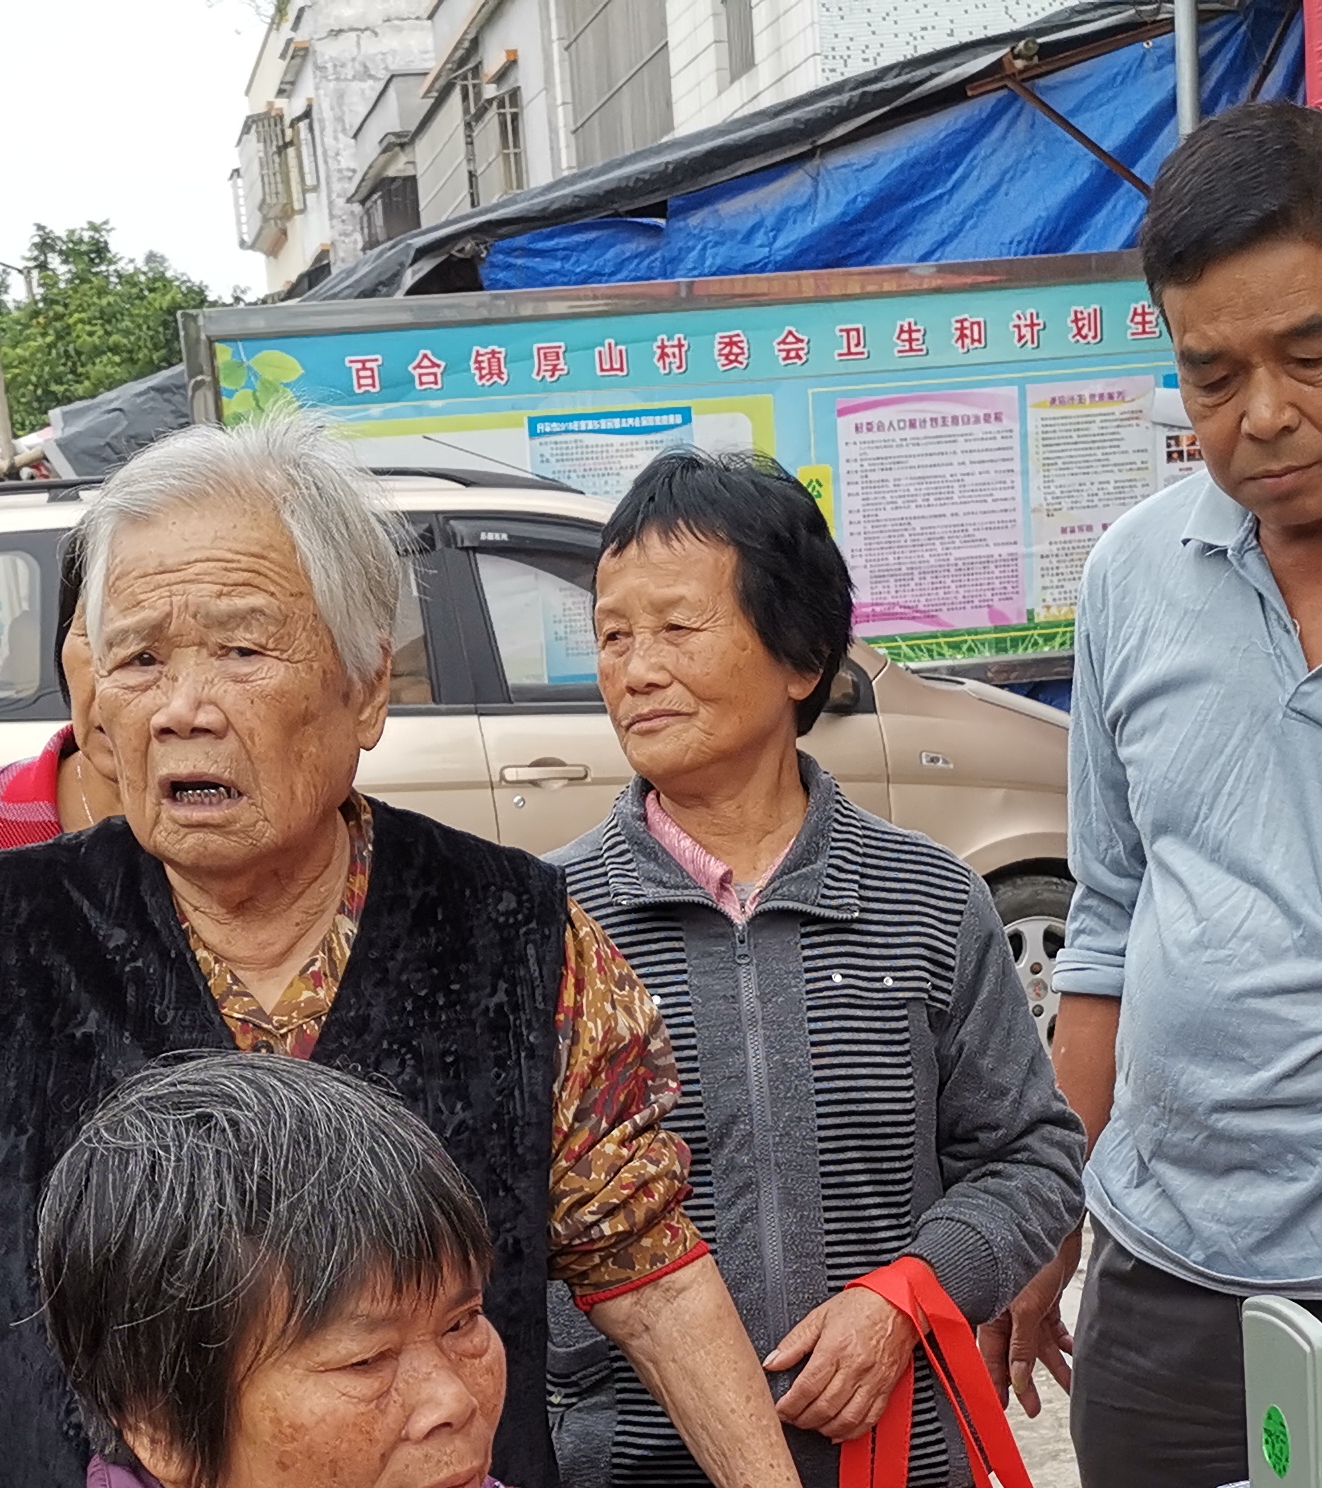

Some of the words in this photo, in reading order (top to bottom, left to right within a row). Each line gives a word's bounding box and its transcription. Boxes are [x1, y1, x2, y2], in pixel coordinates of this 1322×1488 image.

[345, 302, 1161, 394] 百合镇厚山村委会卫生和计划生
